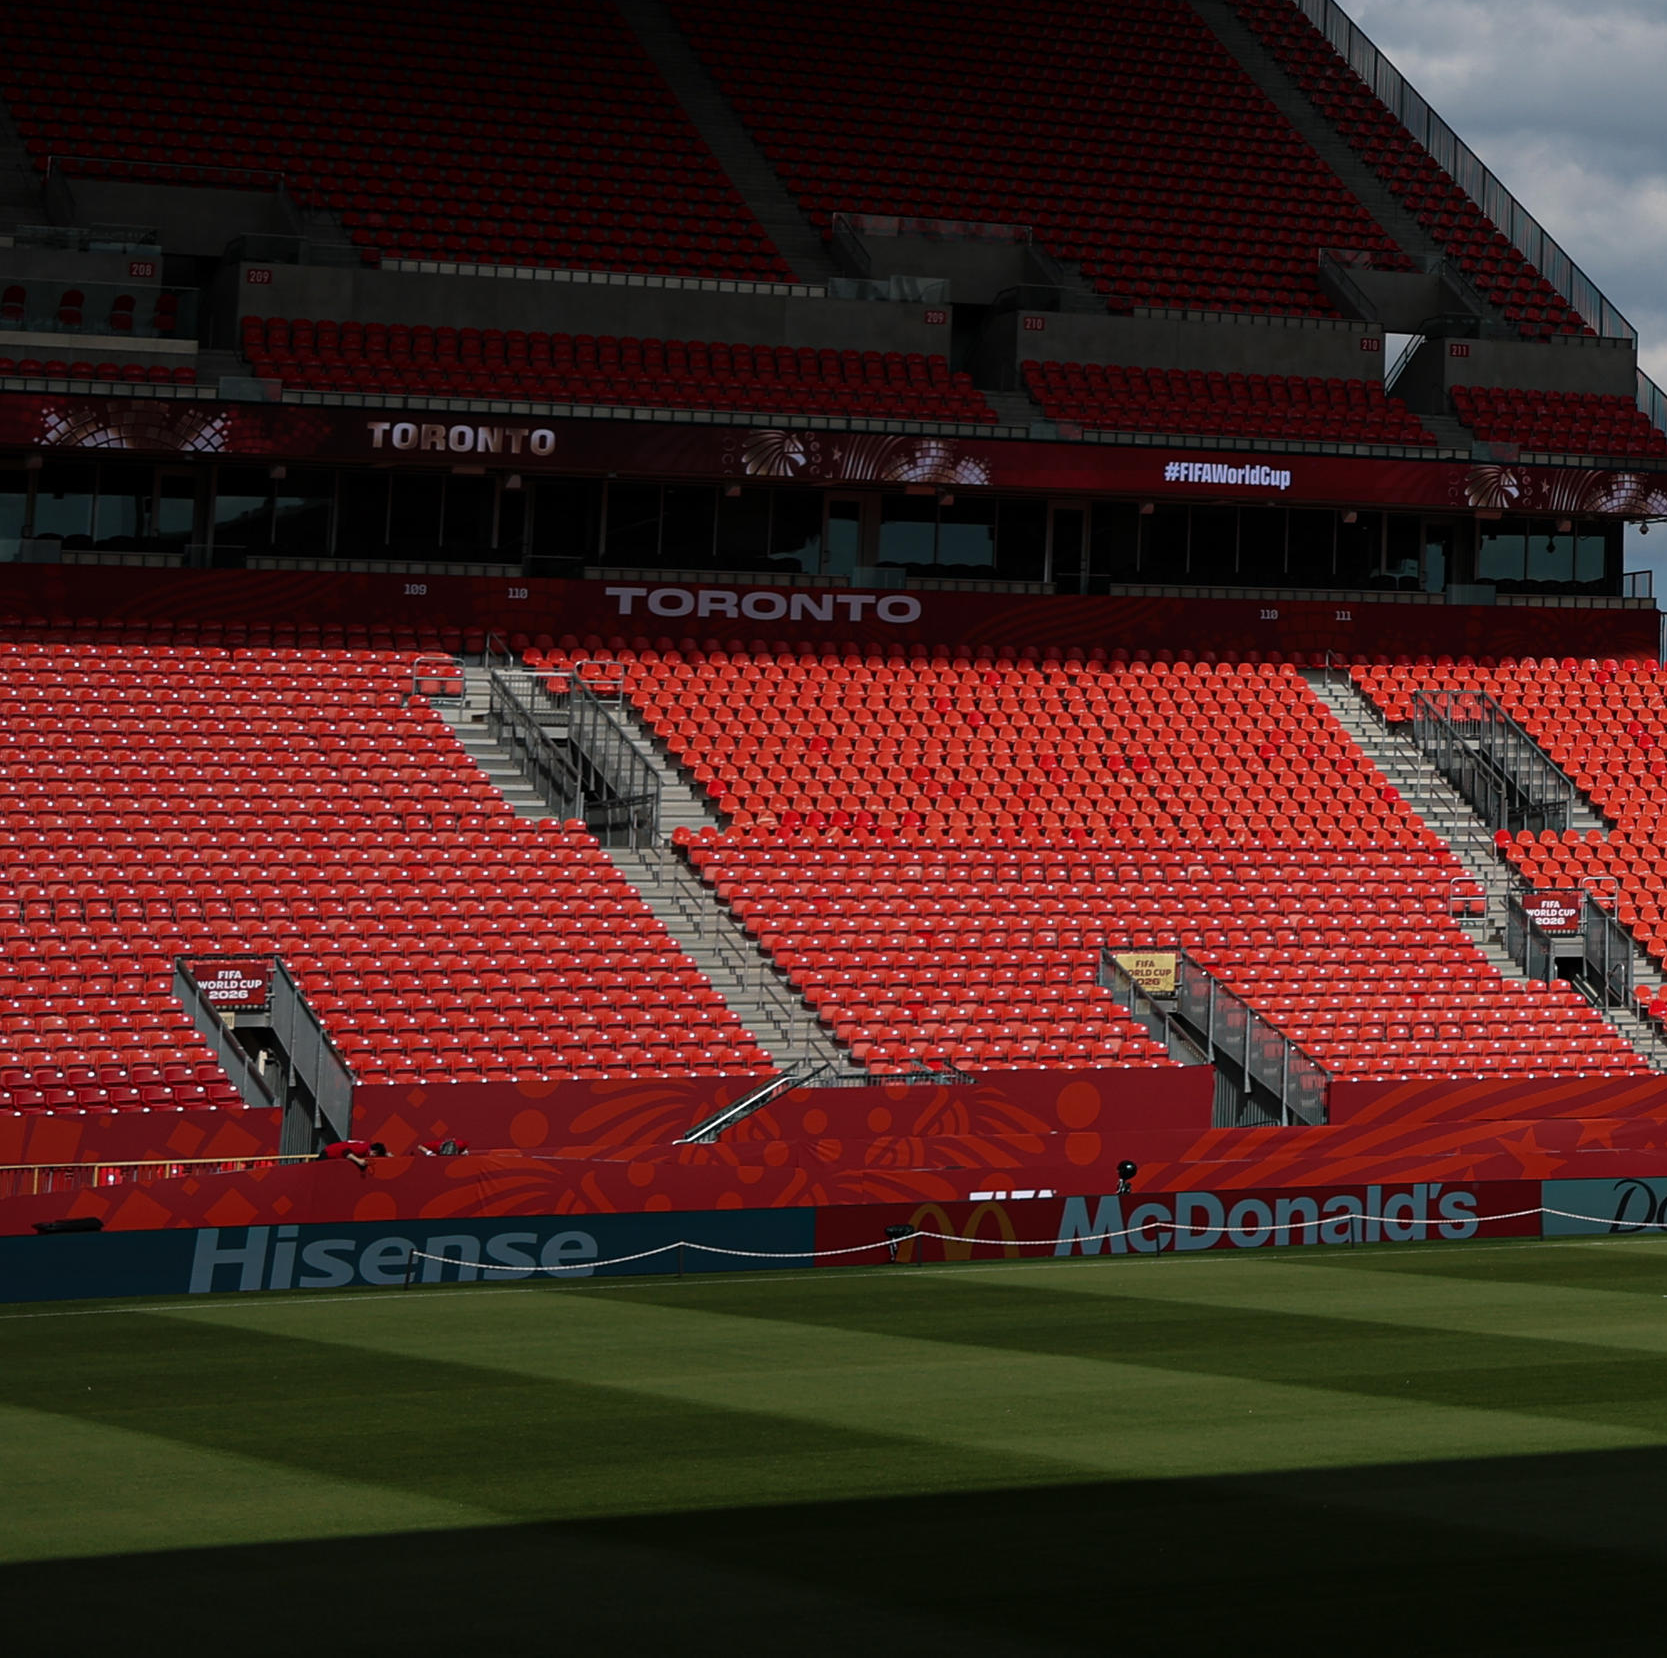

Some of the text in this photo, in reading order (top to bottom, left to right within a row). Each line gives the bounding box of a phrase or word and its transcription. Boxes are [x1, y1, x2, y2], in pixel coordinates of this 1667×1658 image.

[132, 262, 152, 277] 208
[249, 270, 269, 283] 209
[927, 312, 945, 323] 209
[1024, 318, 1042, 329] 210
[1362, 339, 1378, 350] 210
[1451, 345, 1468, 356] 211
[367, 420, 557, 456] TORONTO
[1164, 460, 1291, 490] #FIFAWorldCup
[403, 584, 428, 595] 109
[508, 587, 528, 599] 110
[605, 586, 921, 625] TORONTO
[1260, 609, 1279, 620] 110
[1336, 611, 1352, 621] 111
[1541, 900, 1560, 908] FIFA
[1558, 908, 1576, 917] CUP
[1535, 917, 1566, 925] 2026
[218, 970, 242, 979] FIFA
[197, 979, 262, 990] WORLD CUP
[208, 990, 248, 1000] 2026
[1054, 1183, 1479, 1256] McDonald's
[189, 1225, 598, 1293] Hisense
